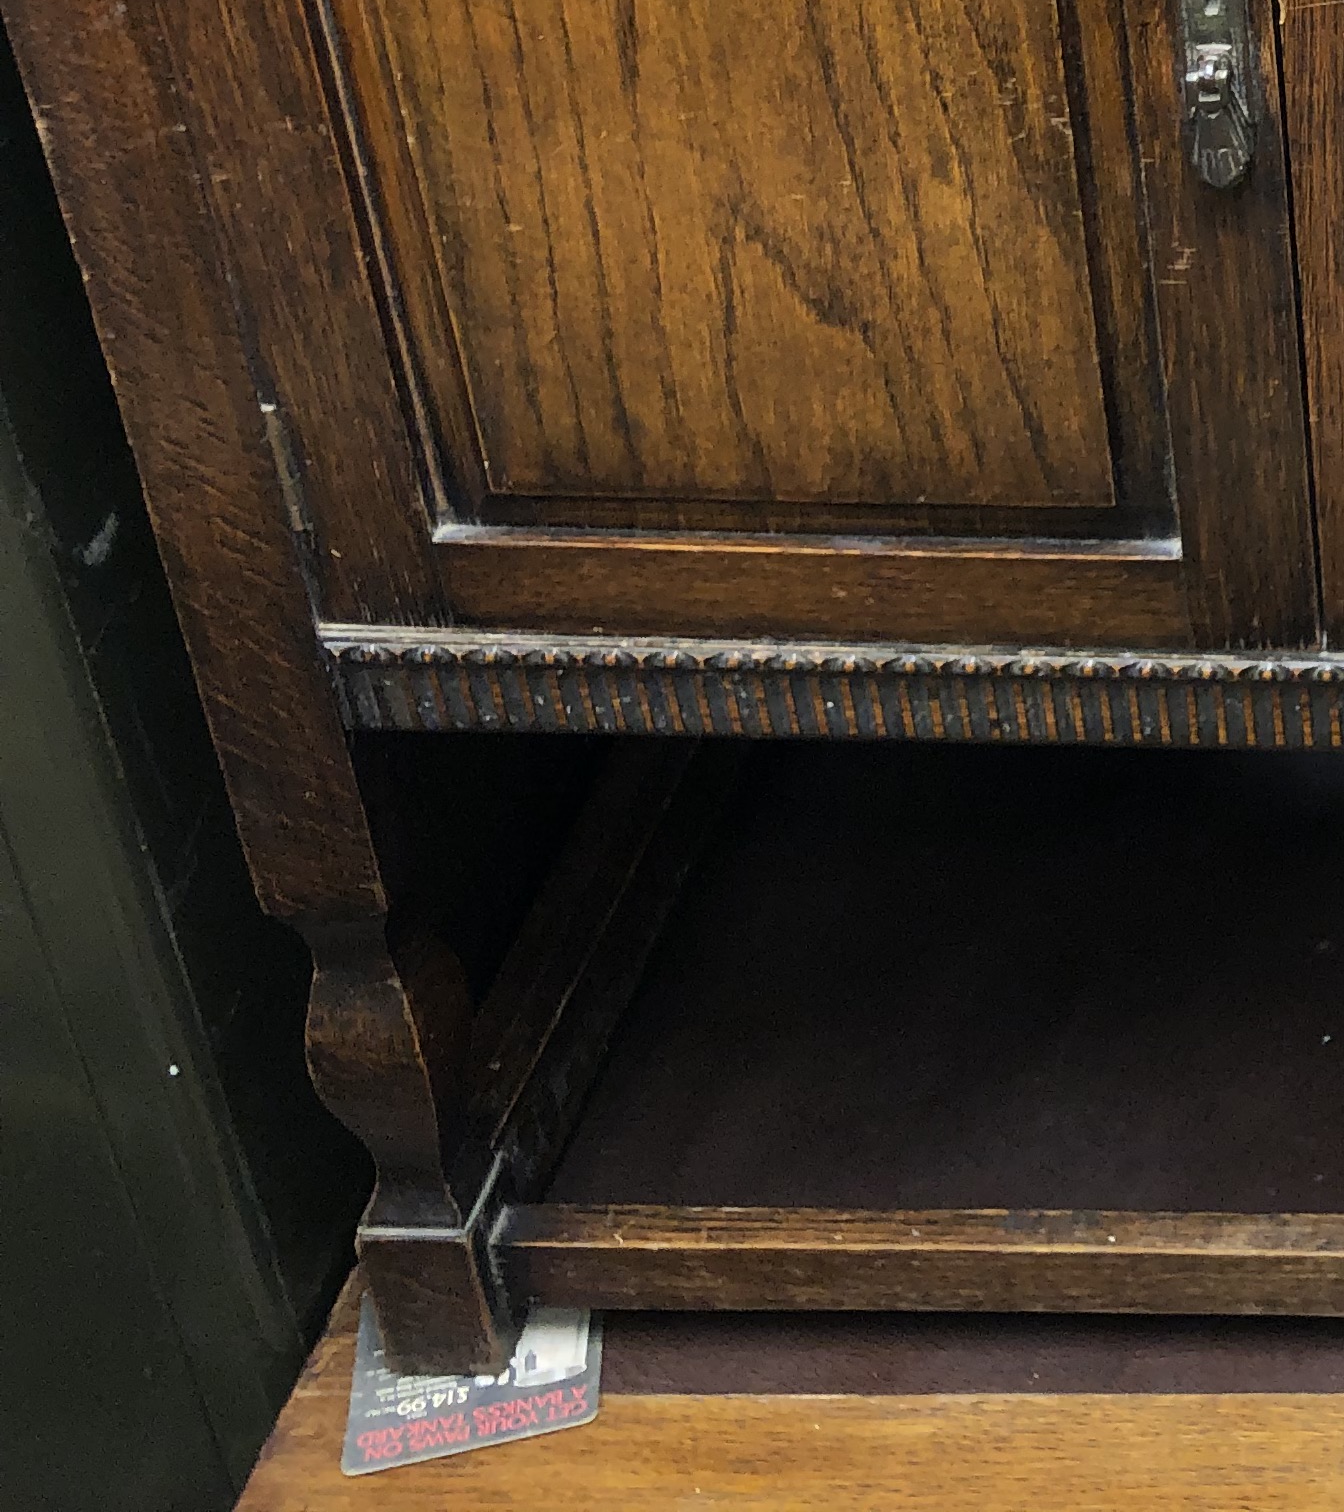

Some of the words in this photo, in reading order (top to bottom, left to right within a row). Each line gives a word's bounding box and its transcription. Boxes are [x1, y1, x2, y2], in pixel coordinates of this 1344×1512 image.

[397, 1385, 470, 1417] £14.99
[571, 1383, 588, 1400] A
[476, 1409, 538, 1437] YOUR
[547, 1398, 588, 1422] GET
[357, 1411, 465, 1448] TANKARD
[409, 1424, 470, 1453] PAWS
[365, 1440, 403, 1463] ON
